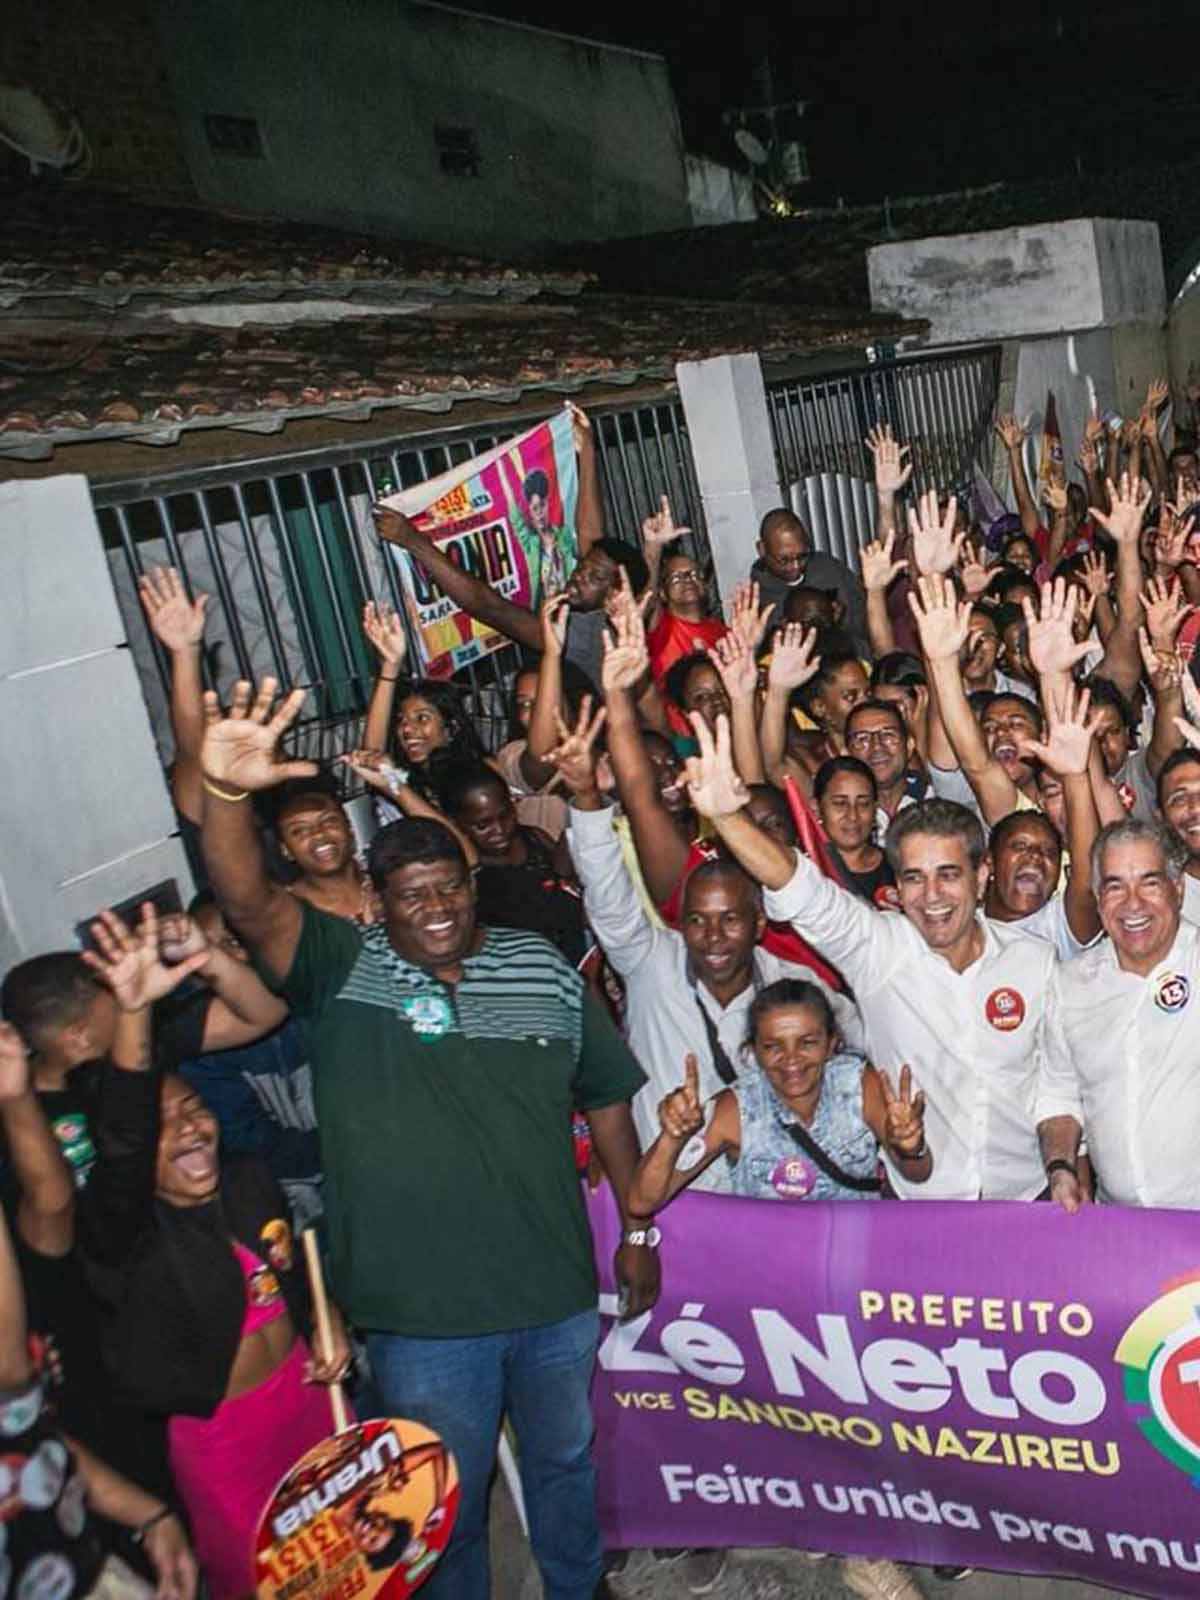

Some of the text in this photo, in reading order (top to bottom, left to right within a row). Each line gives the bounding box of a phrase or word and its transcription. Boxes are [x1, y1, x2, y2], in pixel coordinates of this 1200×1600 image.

[859, 1290, 1094, 1337] PREFEITO
[598, 1293, 1107, 1426] Zé Neto
[614, 1387, 1121, 1476] VICE SANDRO NAZIREU
[273, 1430, 401, 1538] Urania
[659, 1463, 805, 1509] Feira
[811, 1480, 982, 1531] unida
[988, 1509, 1095, 1554] pra
